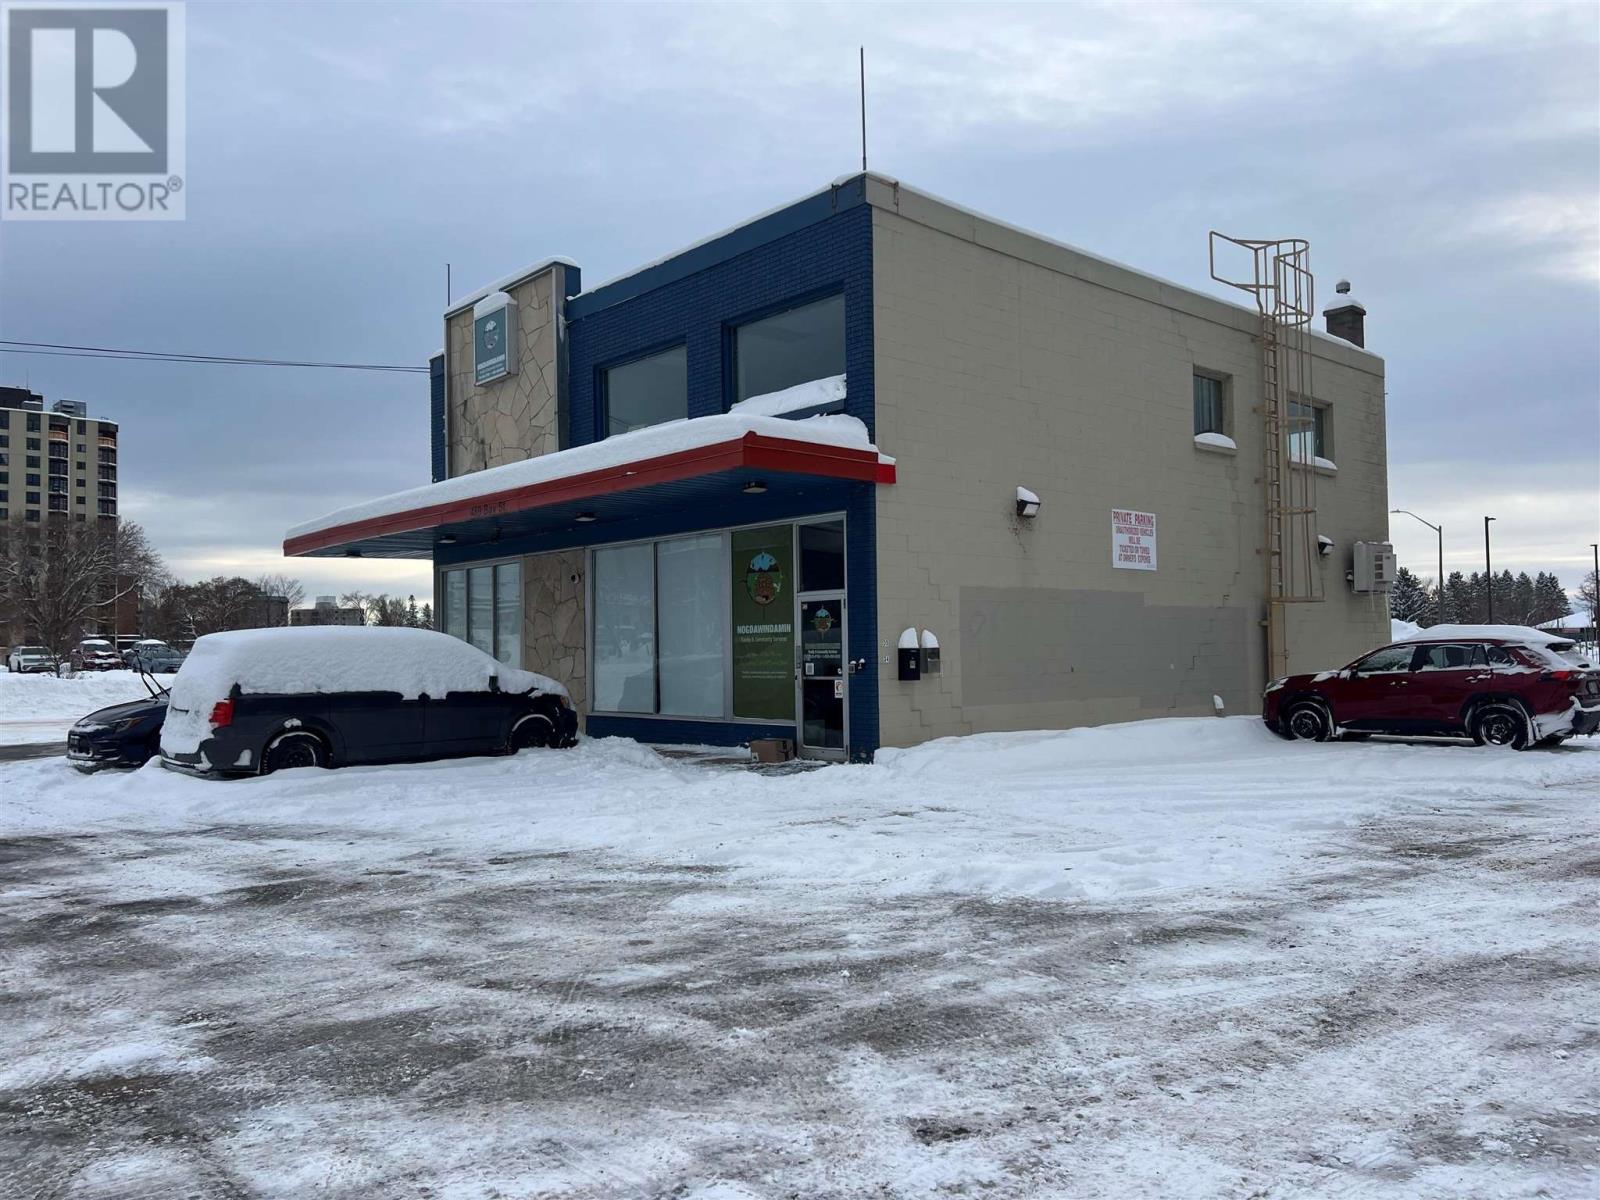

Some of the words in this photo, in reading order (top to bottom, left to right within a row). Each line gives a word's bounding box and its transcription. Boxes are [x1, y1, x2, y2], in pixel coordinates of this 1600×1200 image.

[1113, 511, 1132, 524] PRIVATE
[1135, 513, 1154, 527] PARKING
[1115, 526, 1139, 536] UNAUTHORIZED
[1140, 528, 1153, 537] VEHICLES
[1136, 537, 1141, 545] BE
[1119, 545, 1134, 554] TICKETED
[1134, 546, 1139, 554] OR
[1140, 546, 1150, 555] TOWED
[1138, 555, 1151, 564] EXPENSE
[736, 624, 792, 634] NOGDAWINDAMIN
